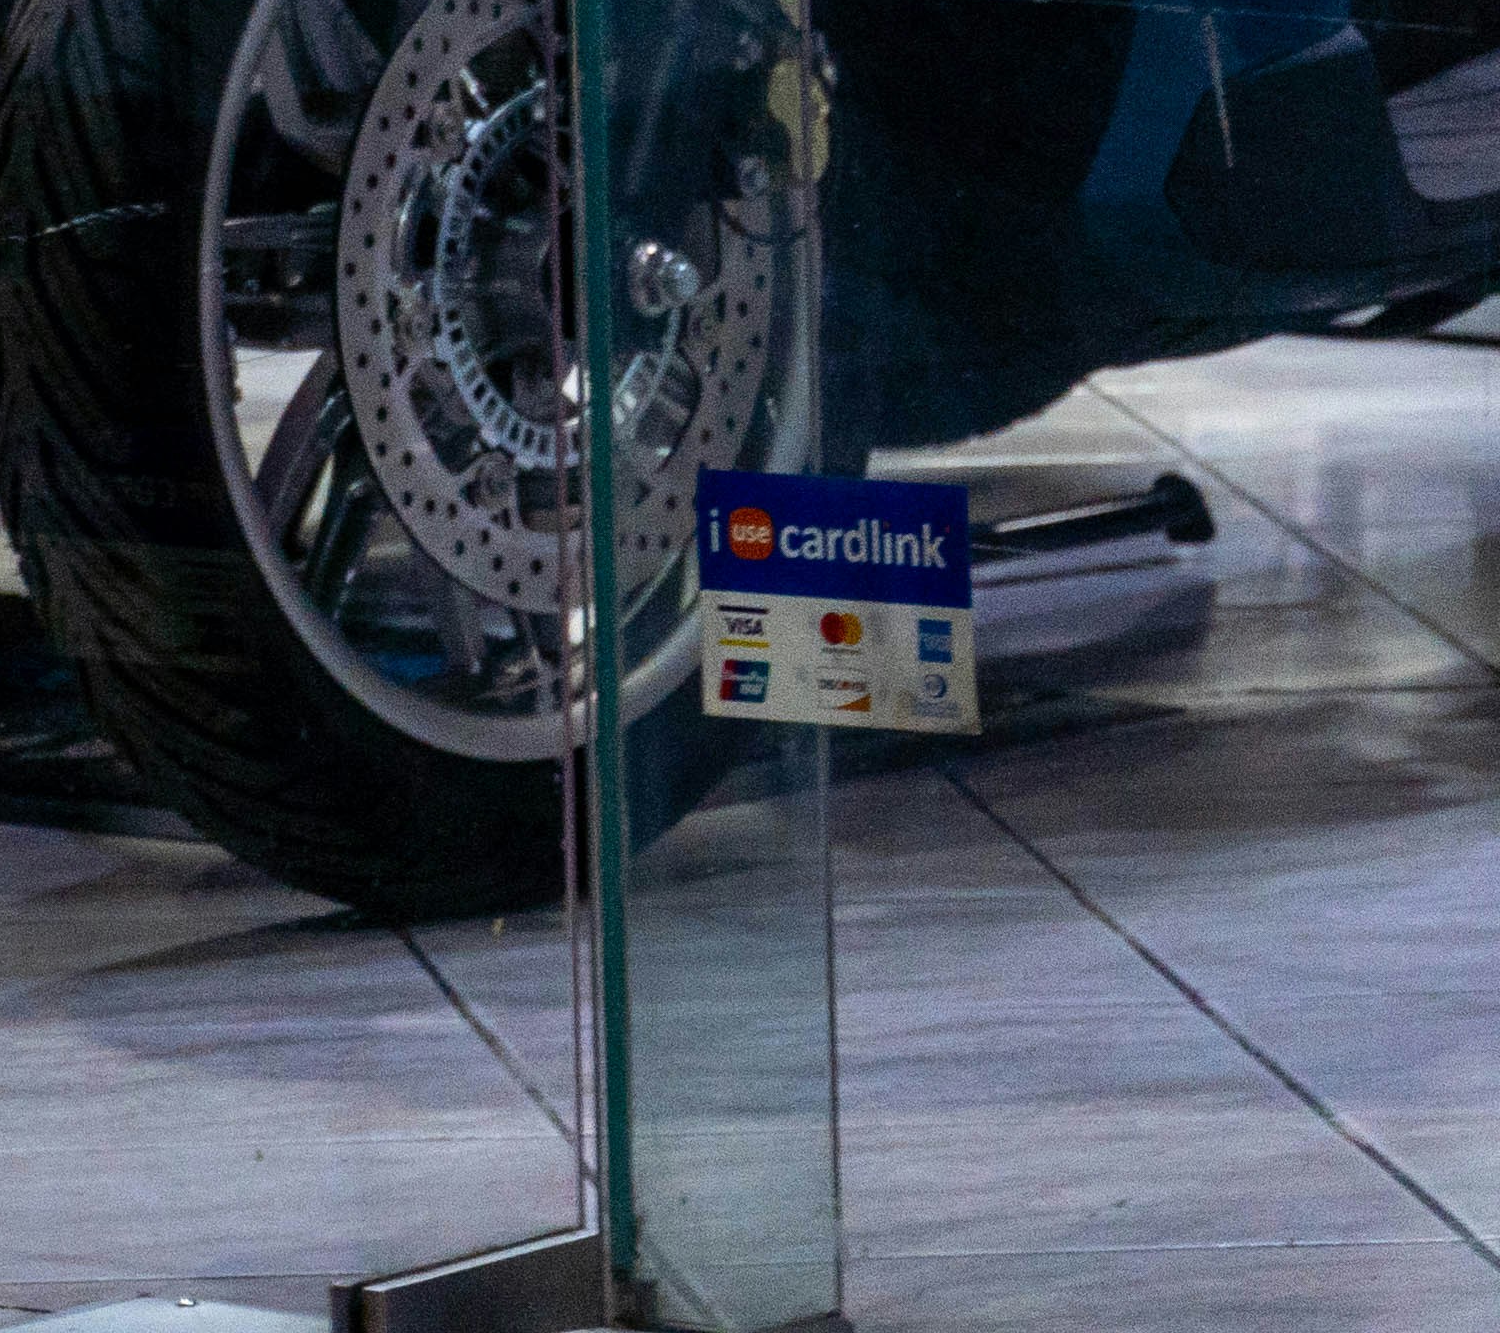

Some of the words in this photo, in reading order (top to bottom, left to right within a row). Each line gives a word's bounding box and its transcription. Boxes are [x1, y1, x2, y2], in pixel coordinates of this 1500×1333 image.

[708, 508, 720, 554] i
[730, 524, 773, 544] use
[779, 518, 948, 569] cardlink
[724, 617, 764, 636] VISA
